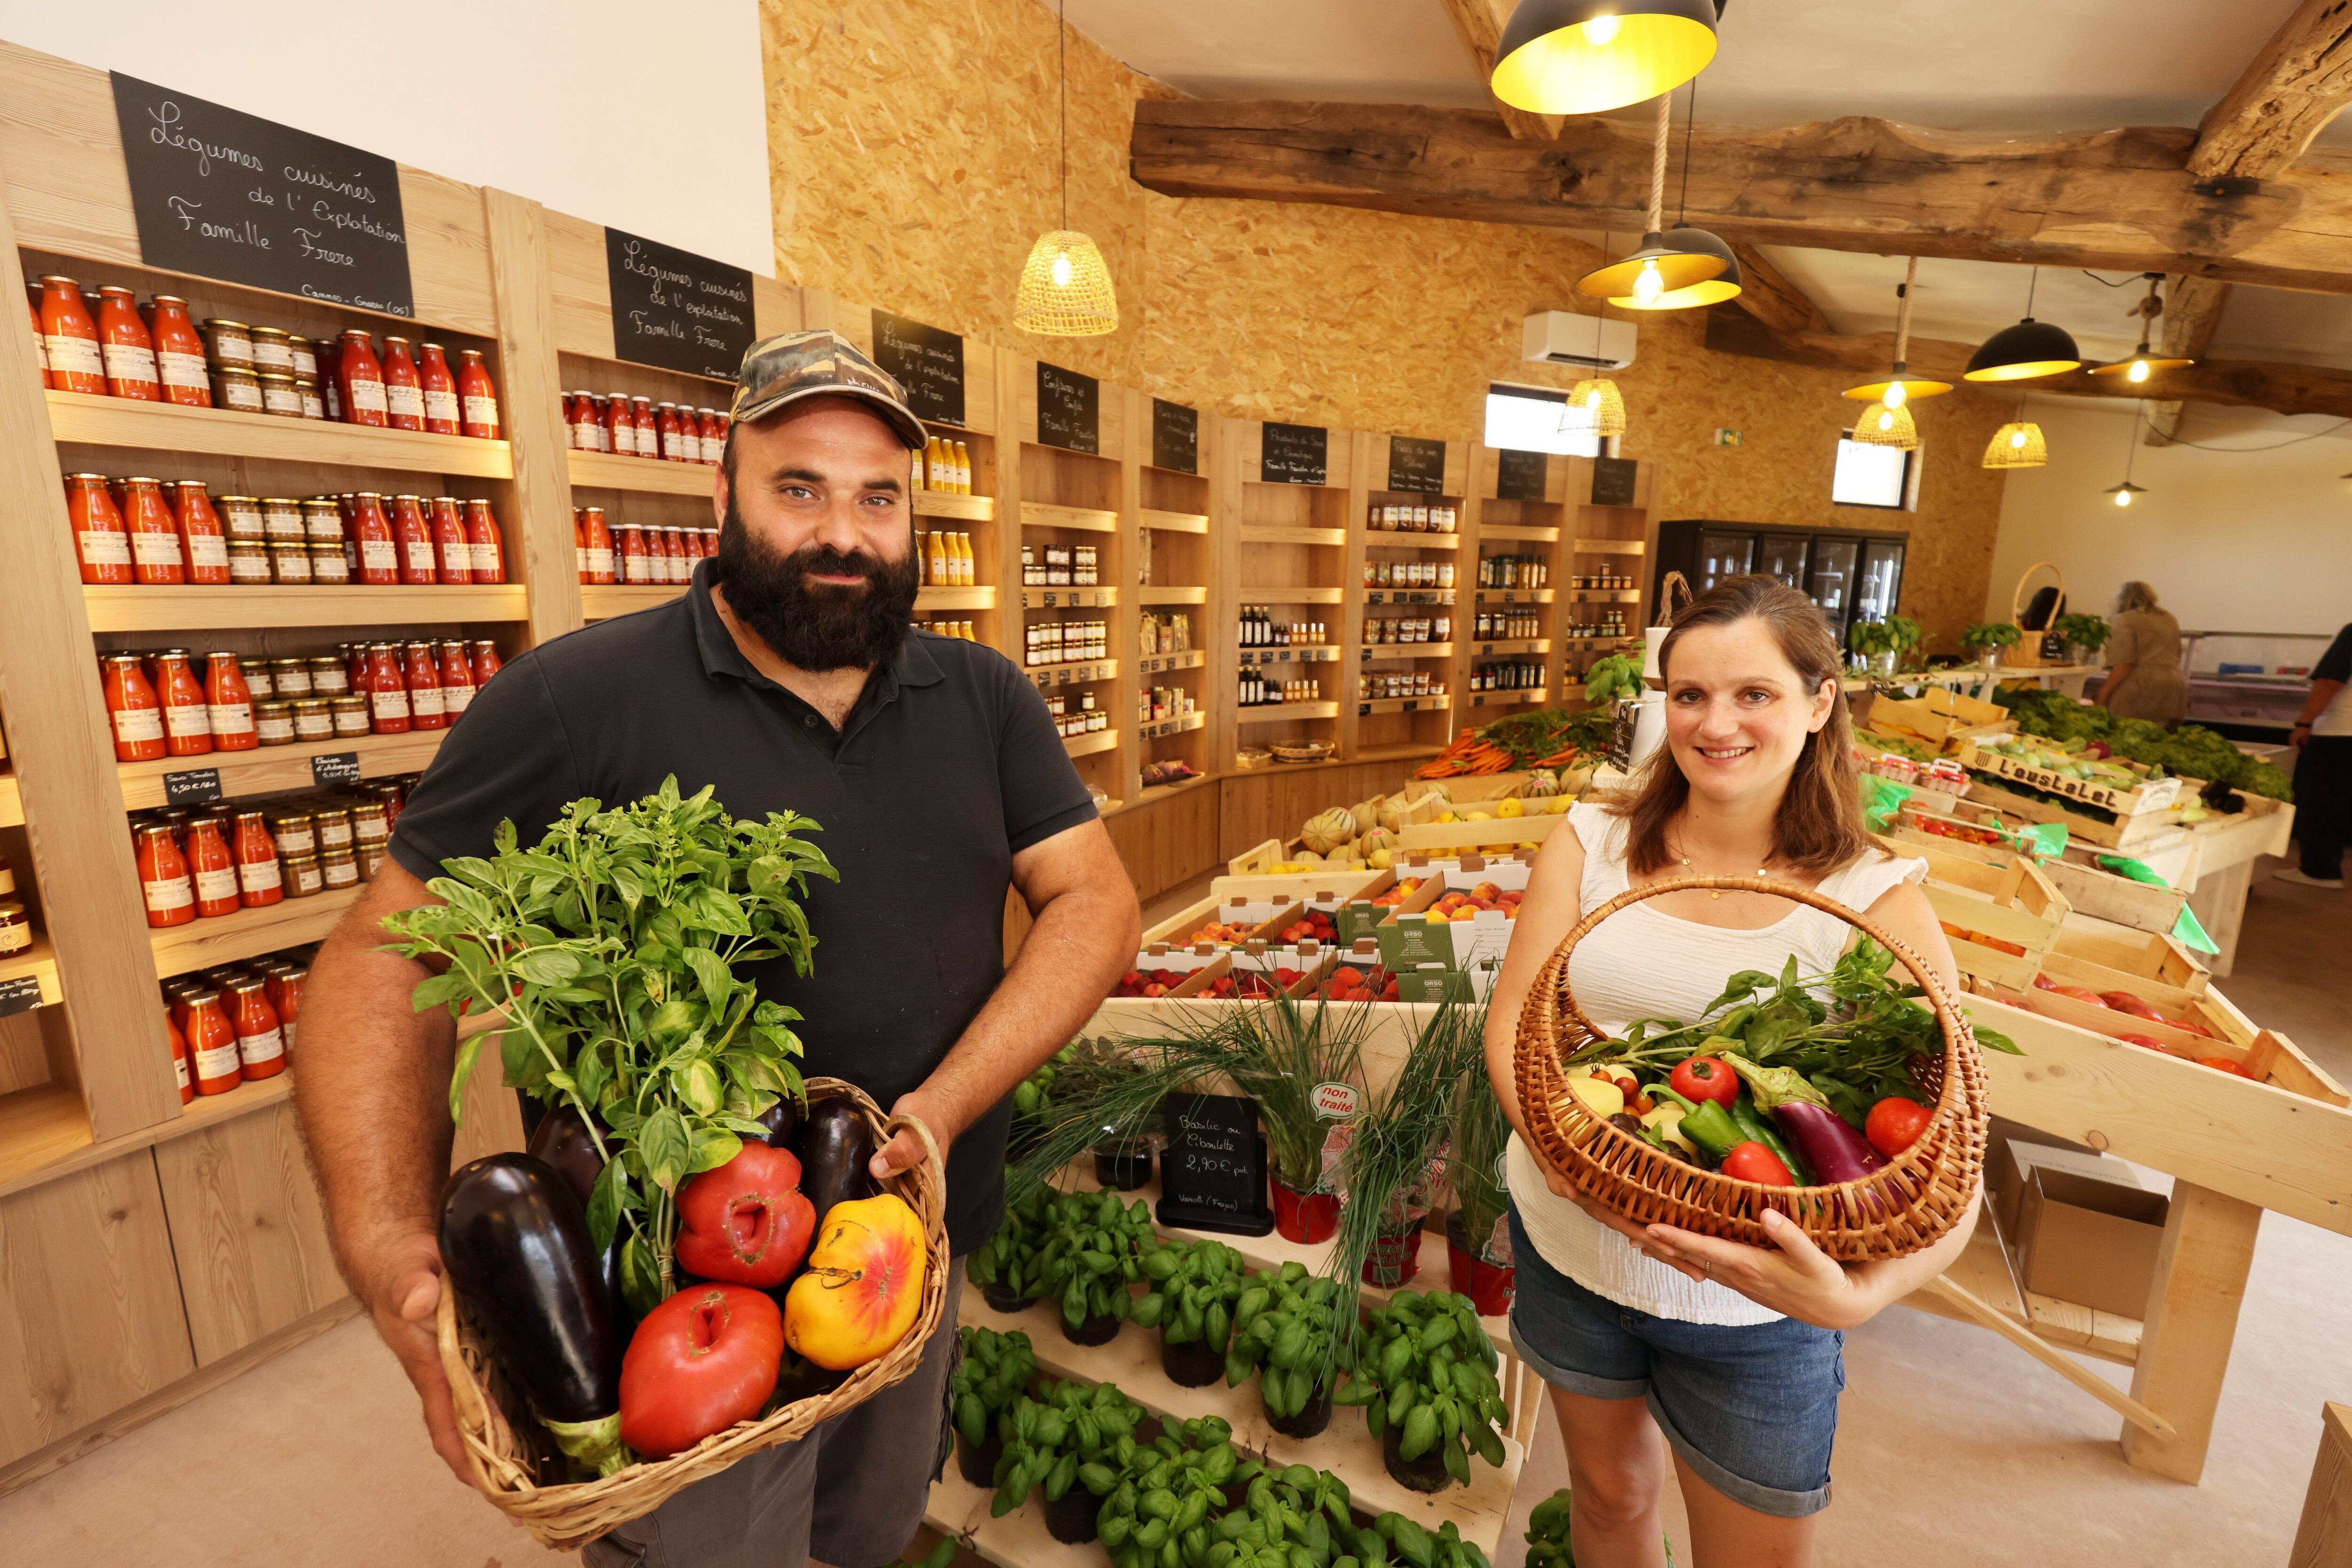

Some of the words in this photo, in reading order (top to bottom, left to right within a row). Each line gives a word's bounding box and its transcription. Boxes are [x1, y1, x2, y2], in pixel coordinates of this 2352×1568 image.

[148, 102, 263, 176] Légumes
[284, 166, 375, 203] cuisinés
[248, 187, 274, 205] de
[168, 196, 272, 249] Famille
[624, 240, 692, 294] Légumes
[700, 281, 747, 302] cuisinés
[650, 292, 667, 306] de
[629, 310, 685, 339] Famille
[1323, 1087, 1349, 1098] non
[1320, 1098, 1353, 1113] traité
[1179, 1115, 1220, 1130] Basilic
[1187, 1133, 1235, 1151] Ciboulette
[1234, 1166, 1249, 1177] pot
